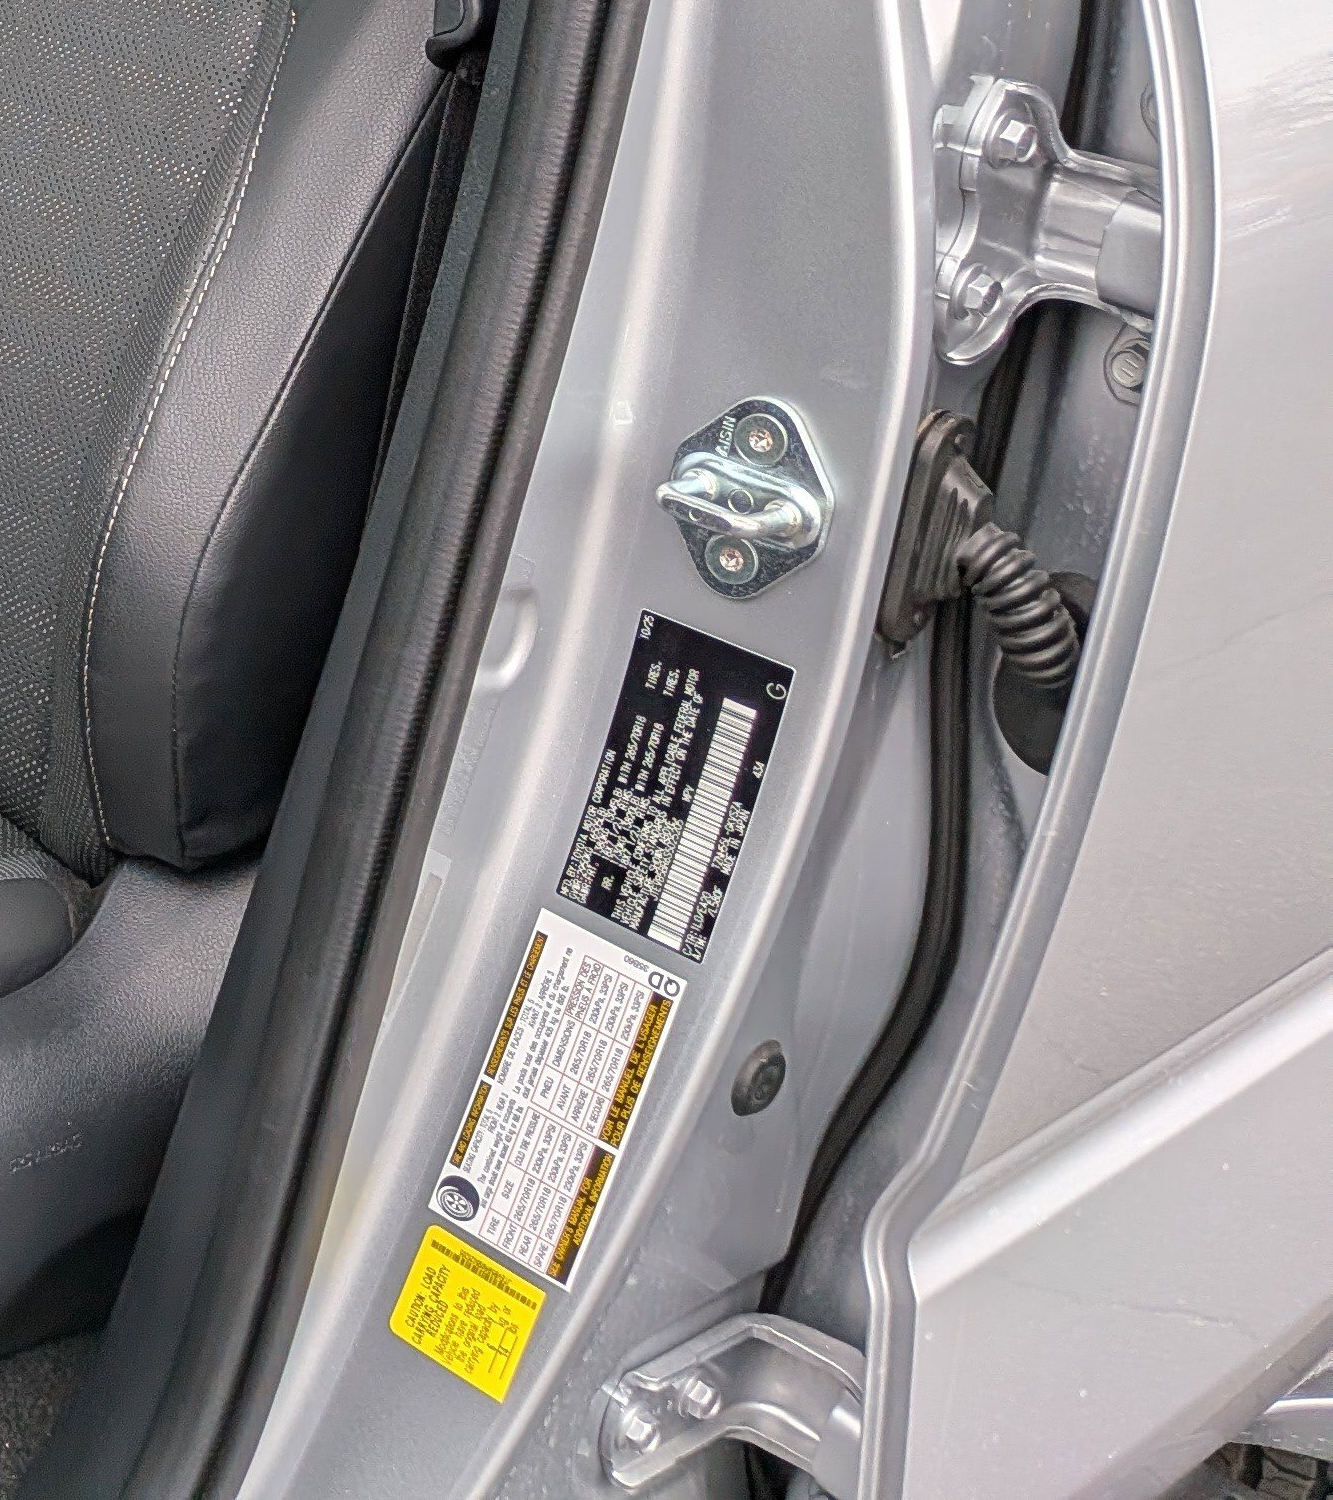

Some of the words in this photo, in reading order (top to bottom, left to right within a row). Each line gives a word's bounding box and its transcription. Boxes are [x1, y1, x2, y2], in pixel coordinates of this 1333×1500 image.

[714, 415, 737, 458] AISIN
[639, 614, 654, 639] 10/25
[645, 661, 662, 689] TIRES.
[624, 715, 646, 760] 265/70R18
[634, 768, 649, 792] WITH
[642, 722, 664, 768] 265/70R18
[662, 669, 680, 696] TIRES.
[679, 729, 693, 745] THE
[684, 705, 700, 728] DATE
[582, 804, 597, 831] MOTOR
[591, 749, 616, 803] CORPORATION
[610, 898, 626, 919] THIS
[619, 861, 639, 897] VEHICLE
[632, 819, 653, 860] CONFORMS
[651, 789, 664, 804] ALL
[658, 735, 681, 785] APPLICABLE
[673, 699, 692, 733] FEDERAL
[683, 668, 699, 696] MOTOR
[617, 761, 632, 784] WITH
[664, 762, 682, 794] EFFECT
[681, 784, 694, 802] MPV
[644, 809, 667, 855] STANDARDS
[720, 852, 736, 875] MADE
[732, 808, 750, 836] JAPAN
[632, 856, 650, 888] SAFETY
[620, 888, 640, 924] VEHICLE
[628, 874, 655, 930] MANUFACTURE
[565, 978, 585, 1015] PRESSION
[579, 961, 591, 978] DES
[574, 994, 589, 1019] PNEUS
[587, 962, 601, 985] FROID
[647, 971, 680, 997] QD
[509, 1026, 524, 1049] PLACES
[519, 1005, 532, 1022] TOTAL
[556, 1083, 570, 1110] AVANT
[569, 1030, 592, 1075] 265/70R18
[598, 973, 613, 996] 33PSI
[585, 1039, 607, 1083] 265/70R18
[614, 981, 629, 1004] 33PSI
[539, 1076, 554, 1099] PNEU
[551, 1019, 575, 1067] DIMENSIONS
[589, 1096, 605, 1123] SECOURS
[601, 1047, 623, 1092] 265/70R18
[630, 989, 645, 1012] 33PSI
[609, 1120, 625, 1147] POUR
[620, 1095, 635, 1120] PLUS
[636, 999, 671, 1078] RENSEIGNEMENTS
[600, 1119, 614, 1141] VOIR
[614, 1068, 634, 1103] MANUEL
[486, 1216, 500, 1235] TIRE
[501, 1179, 514, 1199] SIZE
[513, 1150, 525, 1166] COLD
[589, 1153, 613, 1202] INFORMATION
[501, 1222, 517, 1249] FRONT
[513, 1177, 535, 1222] 265/70R18
[518, 1235, 532, 1257] REAR
[528, 1186, 551, 1231] 265/70R18
[533, 1242, 549, 1268] SPARE
[544, 1195, 567, 1240] 265/70R18
[547, 1260, 560, 1277] SEE
[579, 1176, 592, 1194] FOR
[411, 1304, 434, 1344] CARRYING
[428, 1264, 450, 1303] CAPACITY
[420, 1266, 436, 1290] LOAD
[426, 1299, 448, 1337] REDUCED
